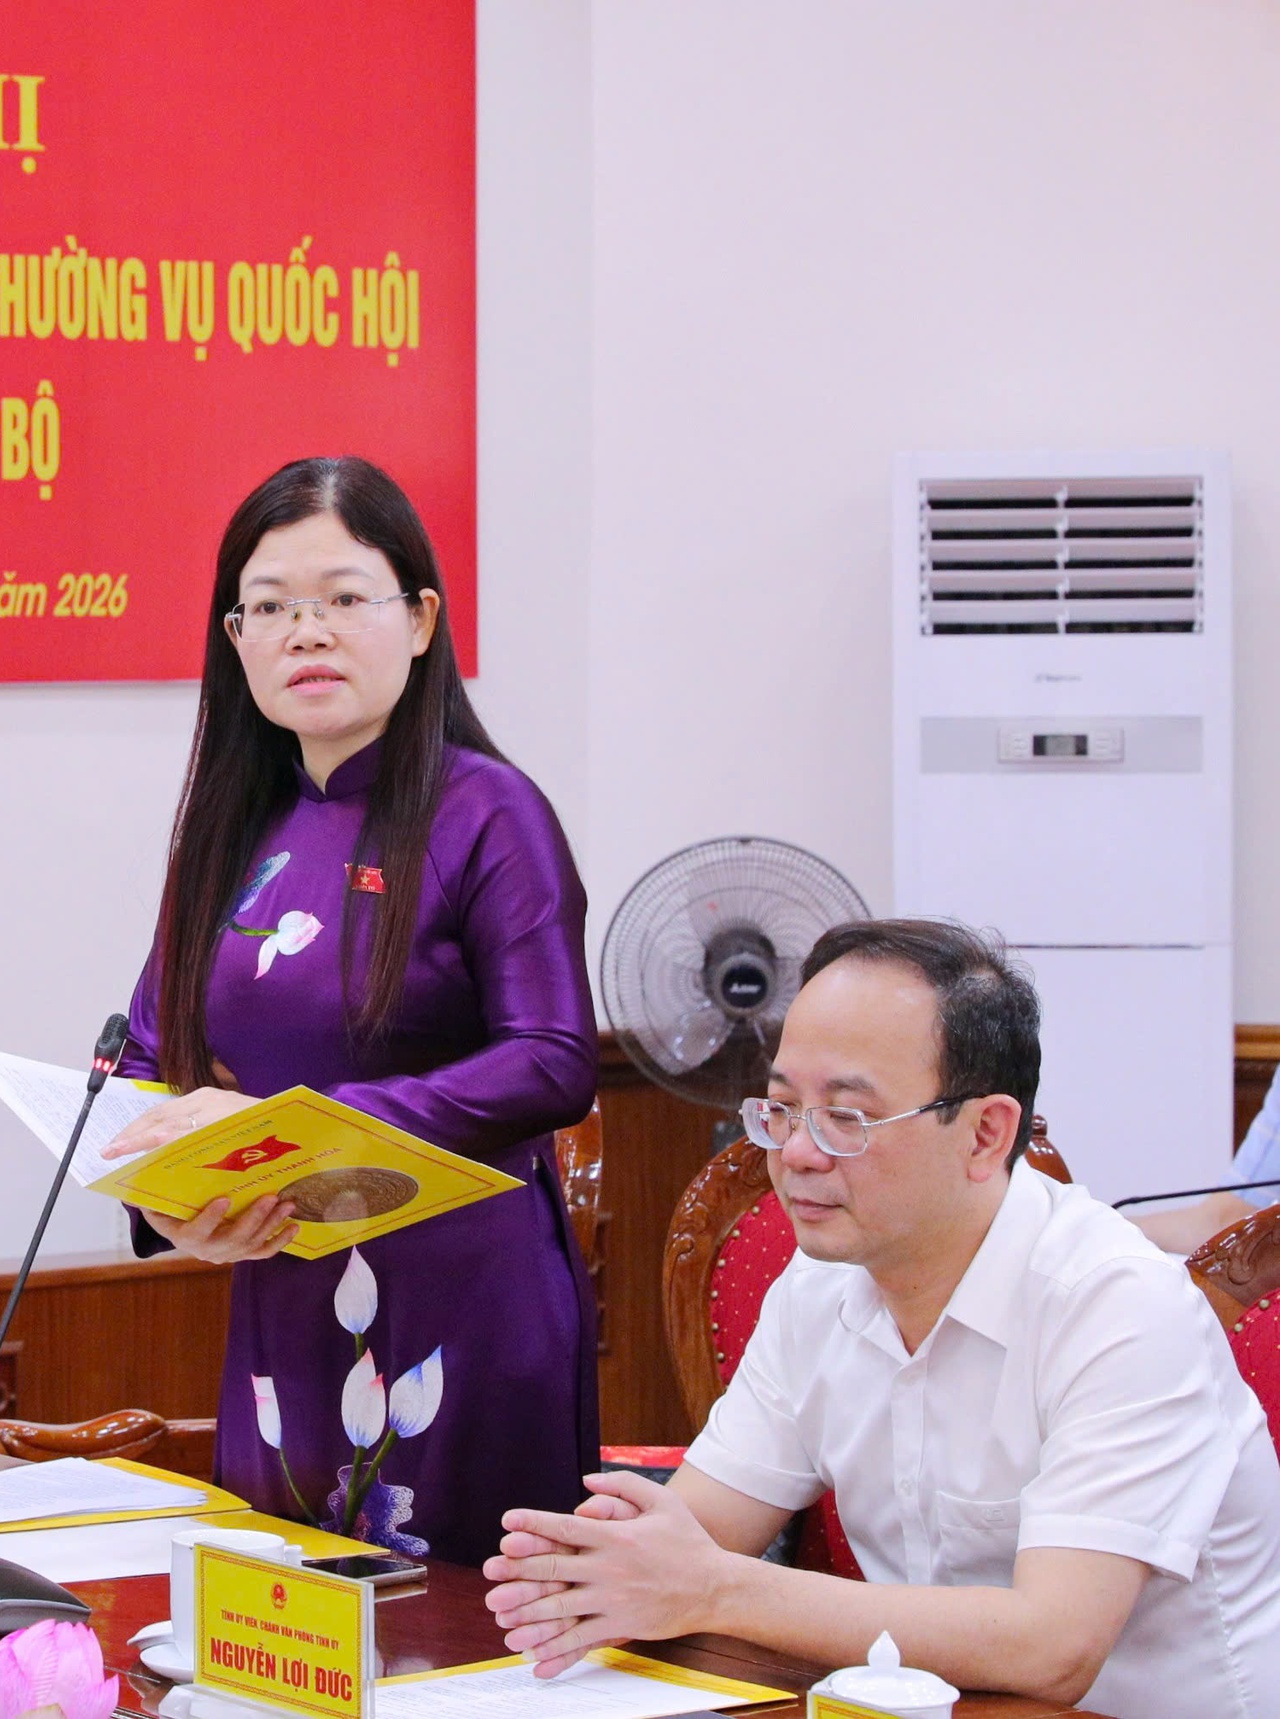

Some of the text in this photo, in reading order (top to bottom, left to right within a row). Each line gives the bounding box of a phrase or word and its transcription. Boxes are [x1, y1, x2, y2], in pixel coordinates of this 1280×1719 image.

[158, 259, 215, 362] VỤ
[227, 235, 340, 354] QUỐC
[351, 251, 420, 368] HỘI
[1, 379, 60, 500] BỘ
[53, 572, 129, 618] 2026
[276, 1156, 316, 1175] THANH
[210, 1637, 276, 1681] NGUYỄN
[282, 1657, 309, 1693] LỢI
[314, 1665, 353, 1702] ĐỨC
